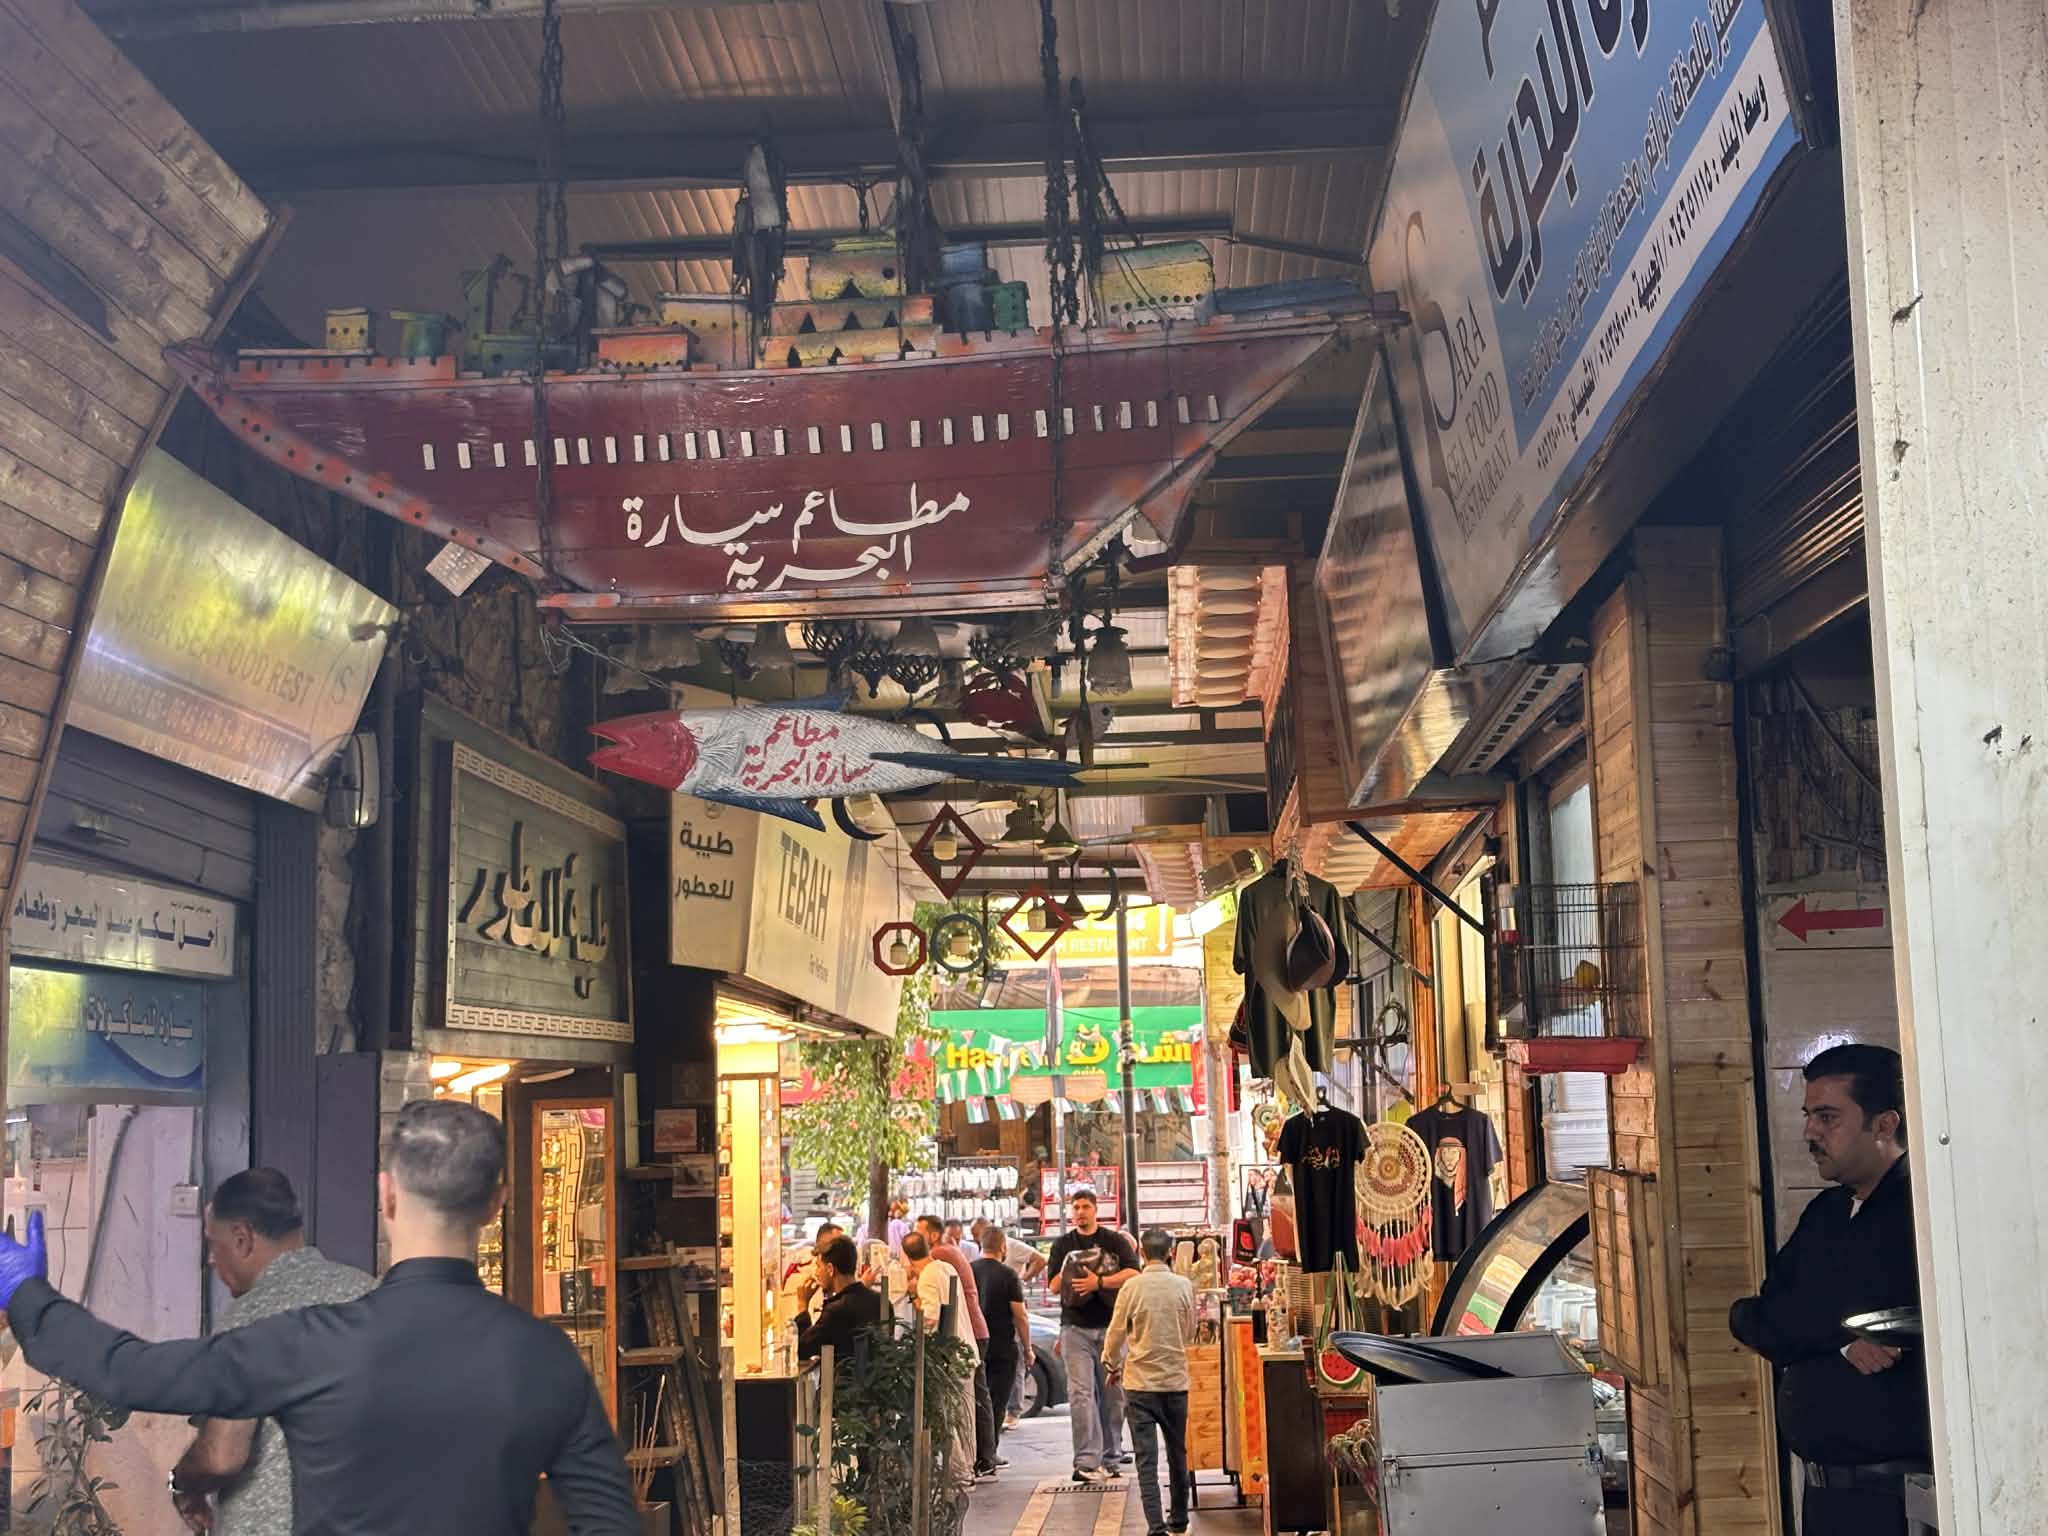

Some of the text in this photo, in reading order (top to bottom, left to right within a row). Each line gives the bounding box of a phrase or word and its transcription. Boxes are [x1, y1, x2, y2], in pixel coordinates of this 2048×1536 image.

[1669, 17, 1716, 126] بالمذاق
[1738, 74, 1769, 135] وسط
[1646, 87, 1674, 194] الرائع
[1718, 103, 1745, 174] البلد
[1609, 160, 1646, 240] وخدمة
[1668, 168, 1713, 249] ٠٦٤٦٥١١١٥
[1465, 370, 1500, 450] FOOD
[622, 481, 971, 554] مطاعم سارة
[725, 533, 914, 592] البحرية
[266, 661, 316, 705] REST
[740, 744, 876, 792] سارة البحرية
[764, 713, 841, 758] مطاعم
[679, 821, 734, 859] طيبة
[674, 874, 735, 901] للعطور
[777, 831, 832, 944] TEBAH
